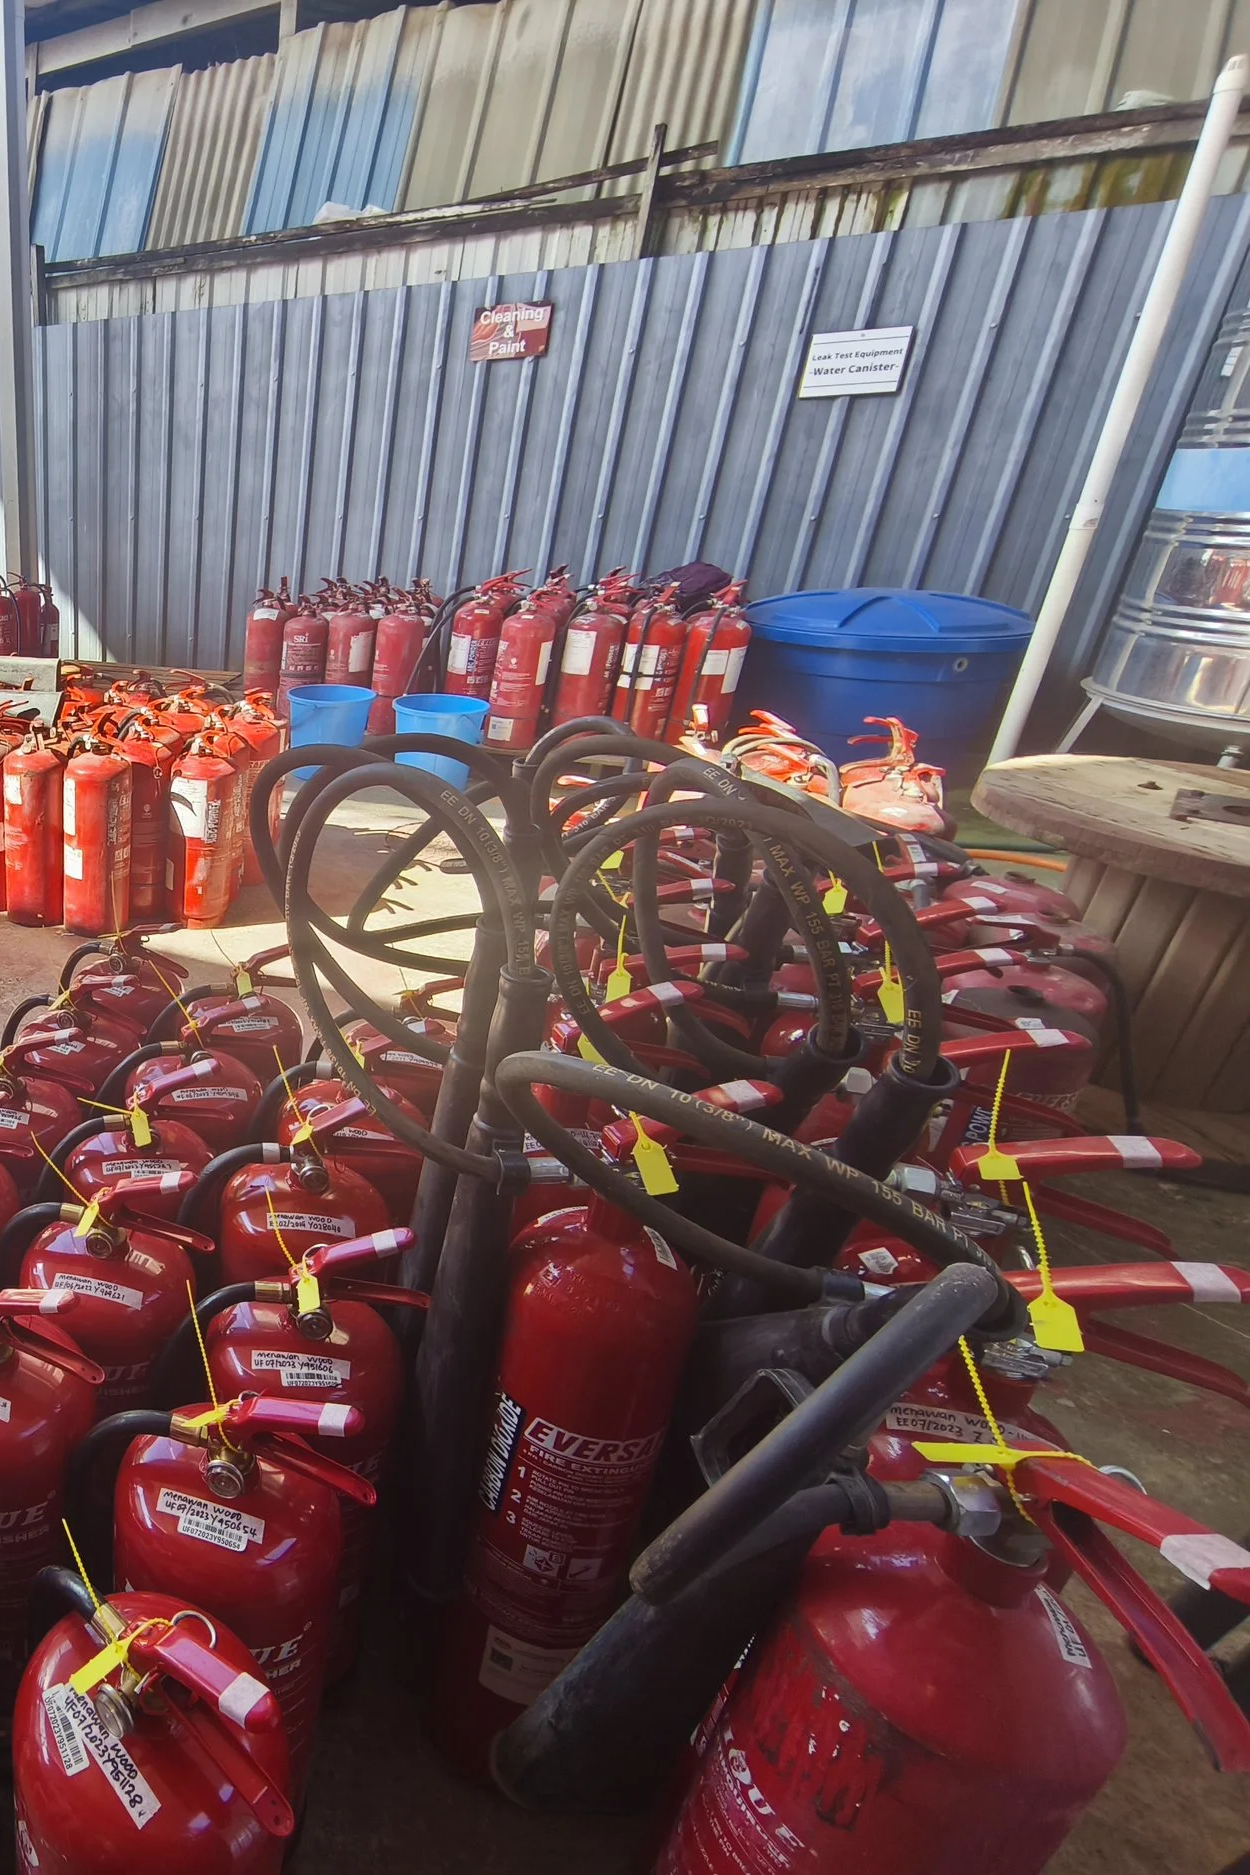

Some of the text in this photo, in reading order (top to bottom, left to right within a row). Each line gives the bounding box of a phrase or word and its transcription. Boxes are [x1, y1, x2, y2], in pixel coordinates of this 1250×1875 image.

[480, 309, 544, 325] Cleaning
[503, 324, 515, 339] &
[488, 340, 527, 355] Paint
[812, 347, 904, 362] Leak Test Equipment
[702, 766, 736, 796] EE DN
[440, 788, 459, 807] EE
[456, 806, 478, 826] DN
[500, 874, 524, 908] MAX
[769, 843, 795, 878] MAX
[789, 880, 811, 906] WP
[805, 910, 824, 936] 155
[815, 938, 837, 969] BAR
[511, 910, 527, 934] WP
[591, 1062, 619, 1078] EE
[625, 1072, 659, 1092] DN
[760, 1125, 814, 1161] MAX
[822, 1154, 861, 1181] WP
[869, 1178, 904, 1206] 155
[909, 1198, 948, 1233] BAR
[479, 1392, 522, 1511] CARBON DIOXIDE
[529, 1444, 567, 1468] FIRE
[517, 1465, 526, 1478] 1
[510, 1488, 522, 1504] 2
[505, 1510, 517, 1524] 3
